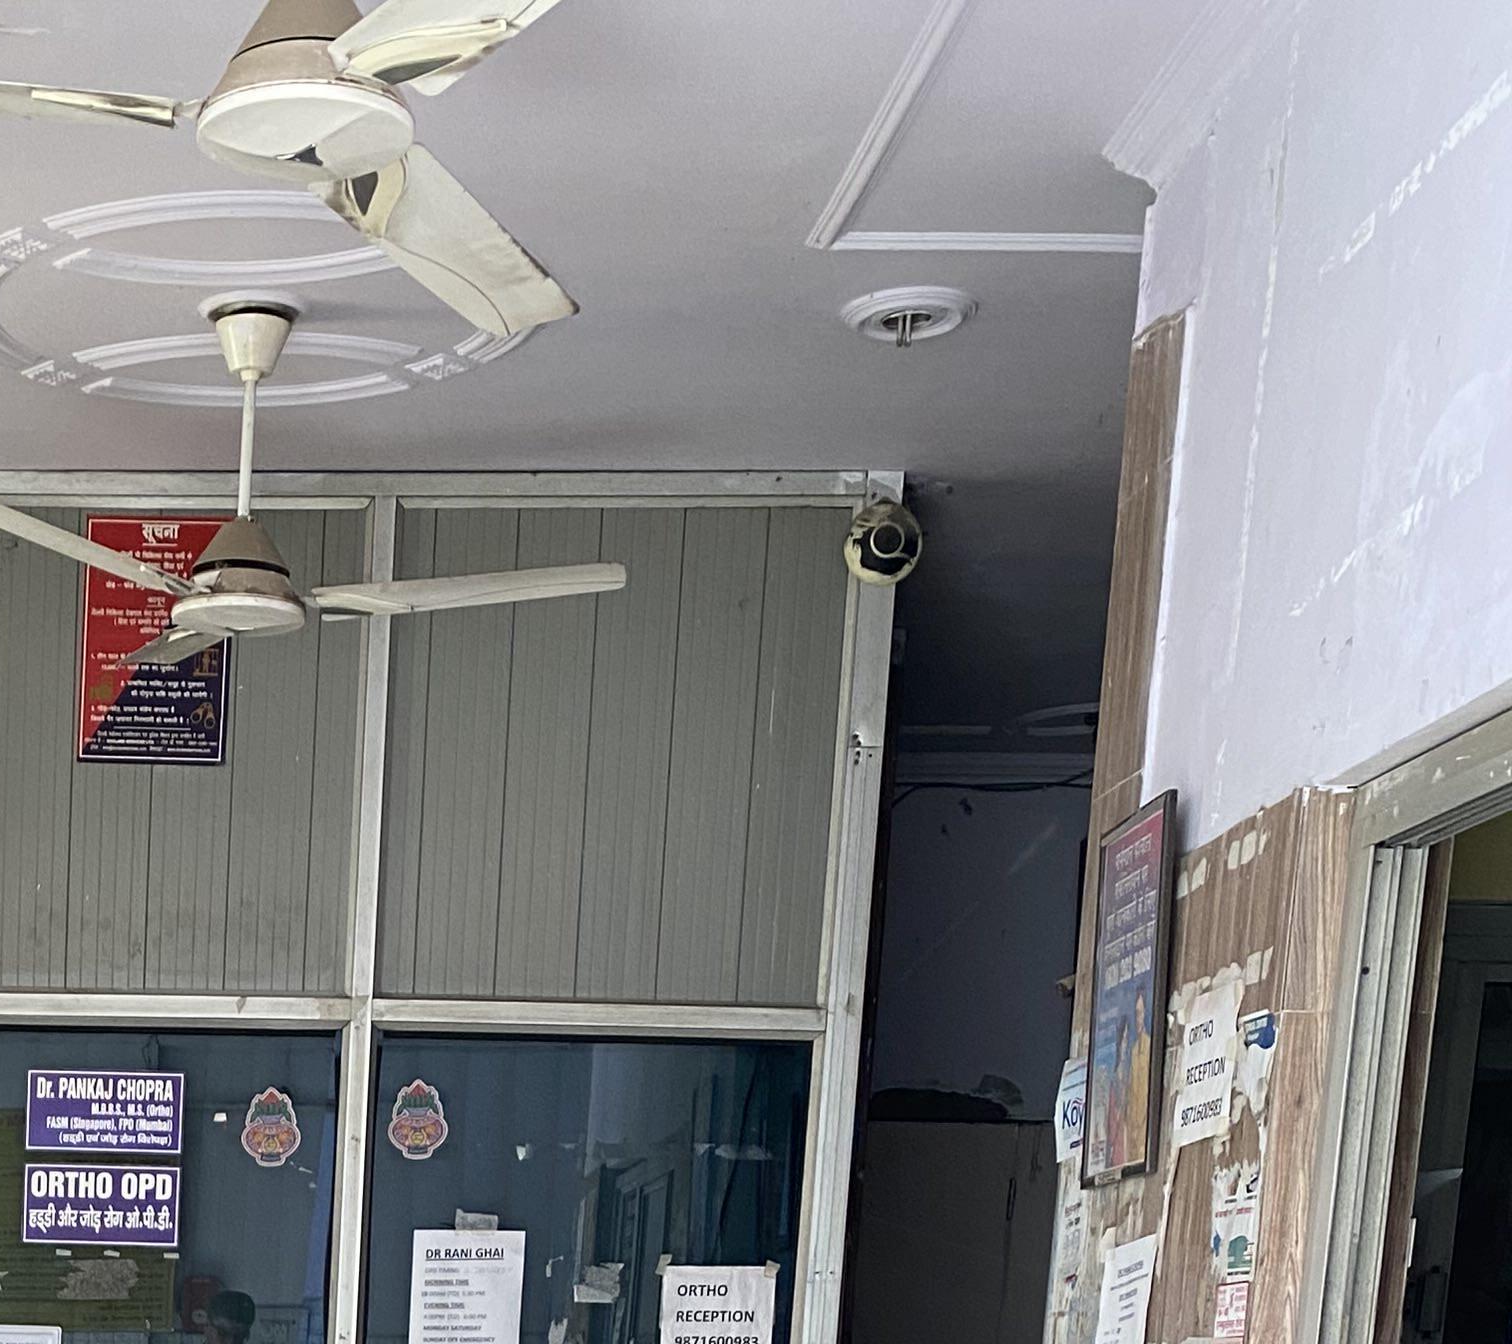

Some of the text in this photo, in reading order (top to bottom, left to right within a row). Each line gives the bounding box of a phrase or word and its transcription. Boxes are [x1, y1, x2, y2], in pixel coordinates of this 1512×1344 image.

[141, 523, 180, 544] सूचना
[1186, 1056, 1226, 1086] RECEPTION
[37, 1077, 174, 1102] Dr. PANKAJ CHOPRA
[46, 1116, 68, 1129] FASM
[30, 1170, 172, 1201] ORTHO OPD
[57, 1203, 77, 1229] और
[79, 1204, 102, 1234] जोड़
[104, 1205, 124, 1229] रोग
[425, 1248, 504, 1260] DR RANI GHAI
[676, 1284, 728, 1297] ORTHO
[675, 1310, 755, 1324] RECEPTION
